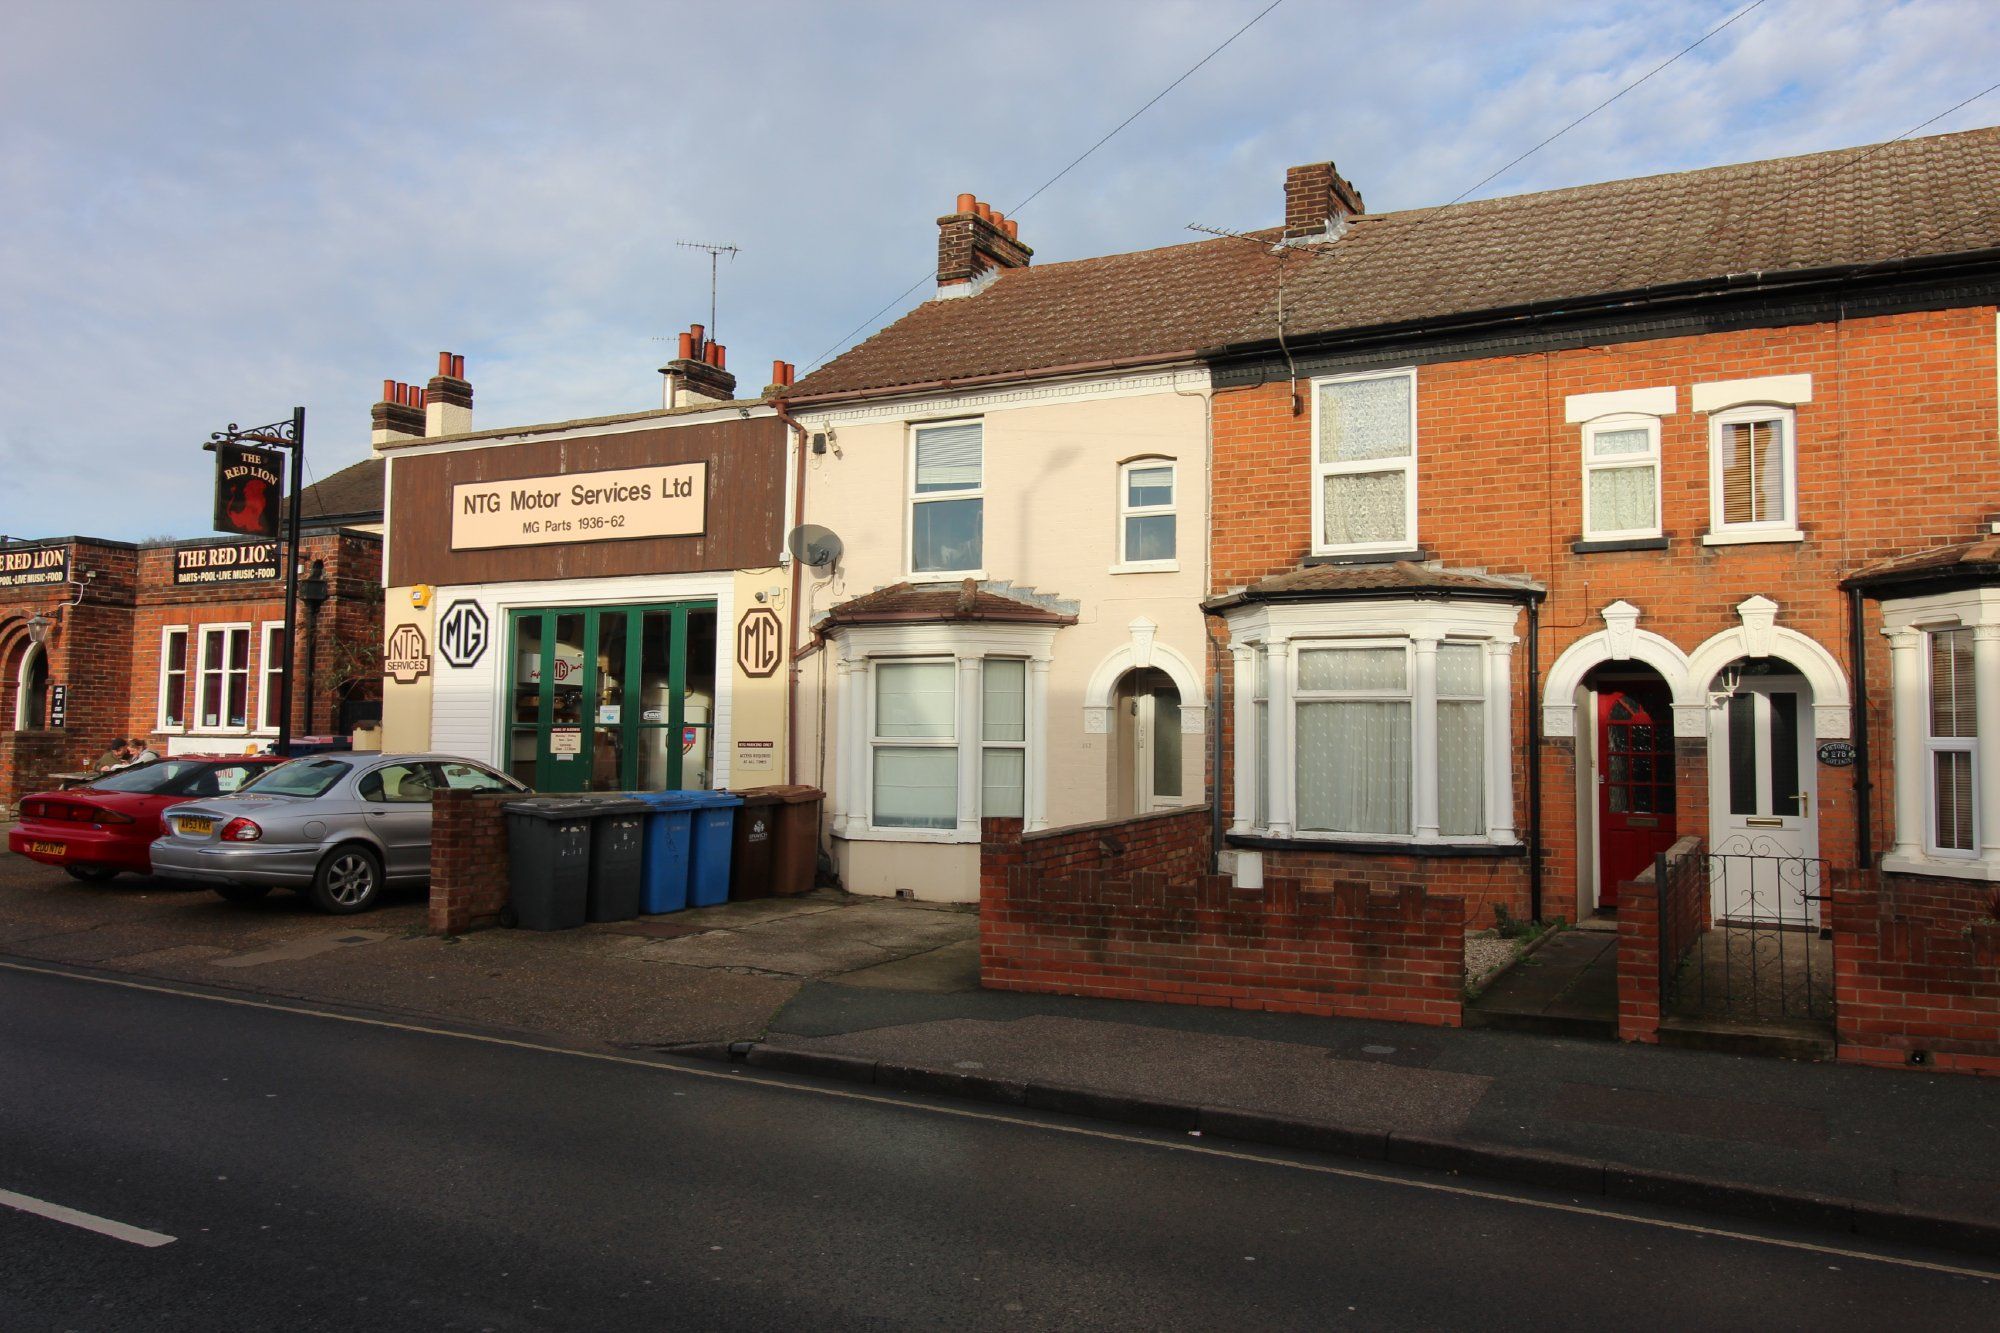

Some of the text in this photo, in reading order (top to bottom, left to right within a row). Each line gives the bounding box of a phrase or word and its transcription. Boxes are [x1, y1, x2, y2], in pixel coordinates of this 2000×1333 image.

[241, 453, 261, 464] THE
[224, 466, 278, 485] RED LION
[464, 476, 692, 515] NTG Motor Services Ltd
[522, 515, 625, 534] MG Parts 1936-62
[5, 553, 31, 571] RED
[33, 549, 65, 569] LION
[178, 550, 207, 569] THE
[208, 547, 237, 566] RED
[393, 629, 420, 660] NTG
[445, 608, 482, 659] MG
[744, 615, 775, 669] MG
[387, 660, 425, 671] SERVICES
[1831, 750, 1847, 758] 278
